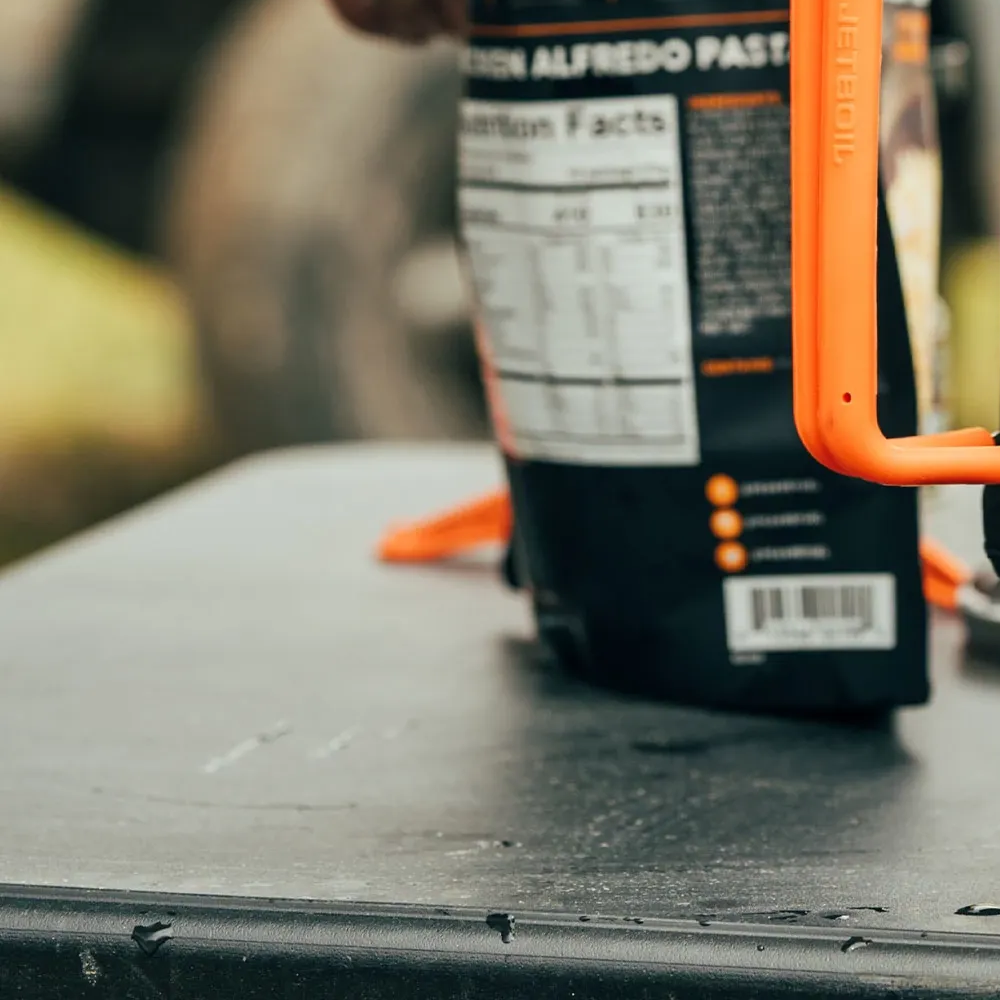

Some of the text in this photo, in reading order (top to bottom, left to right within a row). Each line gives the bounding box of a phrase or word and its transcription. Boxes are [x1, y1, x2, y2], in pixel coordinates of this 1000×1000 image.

[531, 37, 692, 80] ALFREDO
[695, 32, 789, 70] PAST
[832, 2, 860, 166] JETBOIL
[565, 104, 667, 140] Facts
